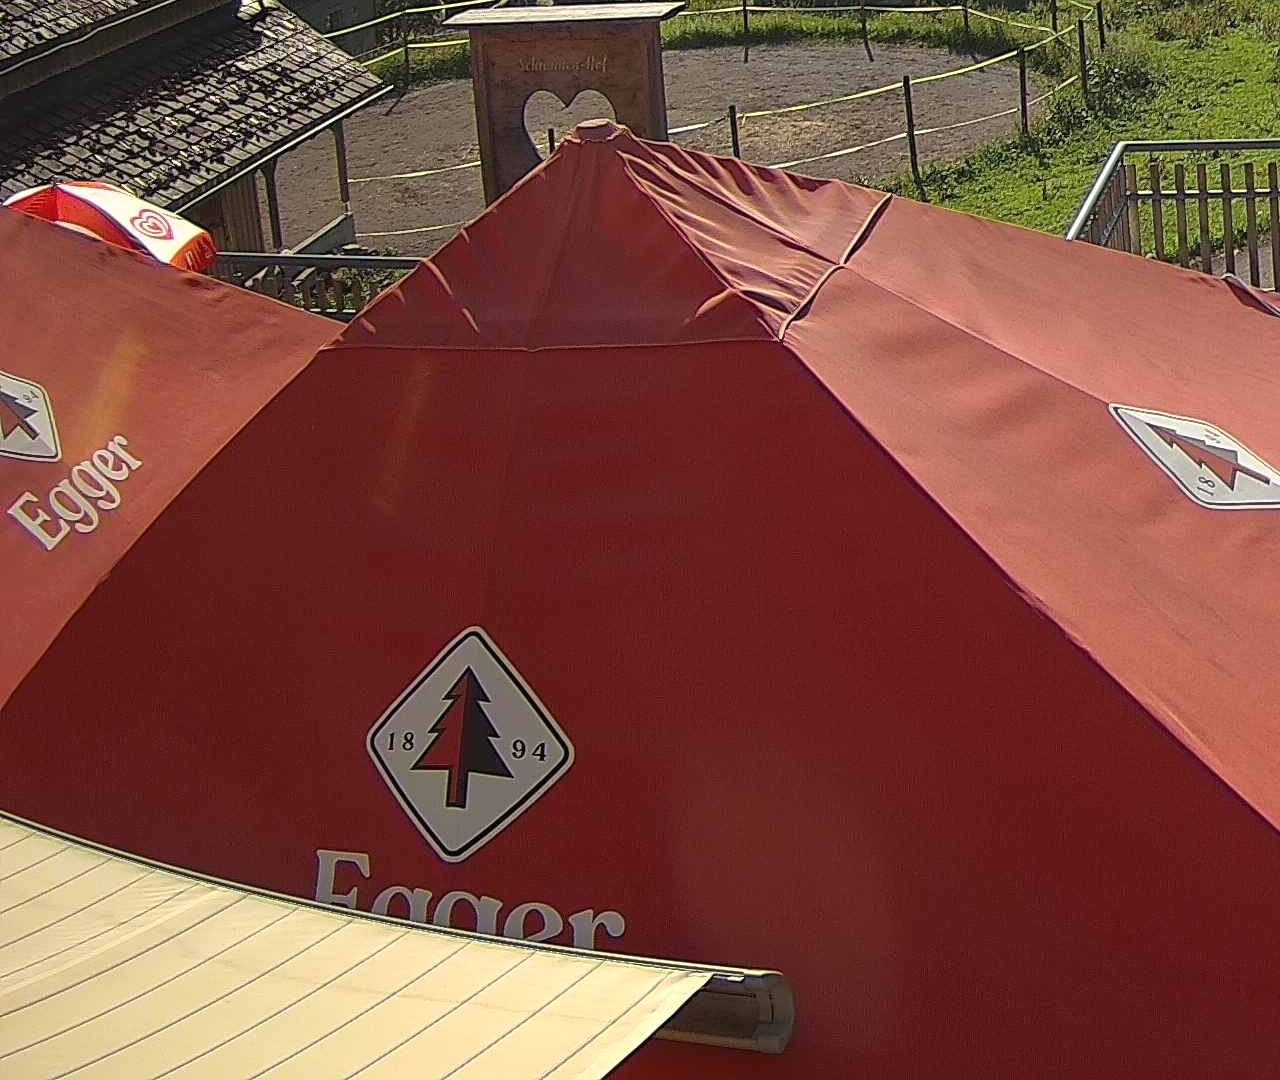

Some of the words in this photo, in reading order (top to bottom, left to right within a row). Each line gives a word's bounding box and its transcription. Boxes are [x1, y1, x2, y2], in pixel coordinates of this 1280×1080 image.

[7, 435, 143, 551] Egger
[386, 731, 415, 751] 18
[511, 740, 547, 762] 94
